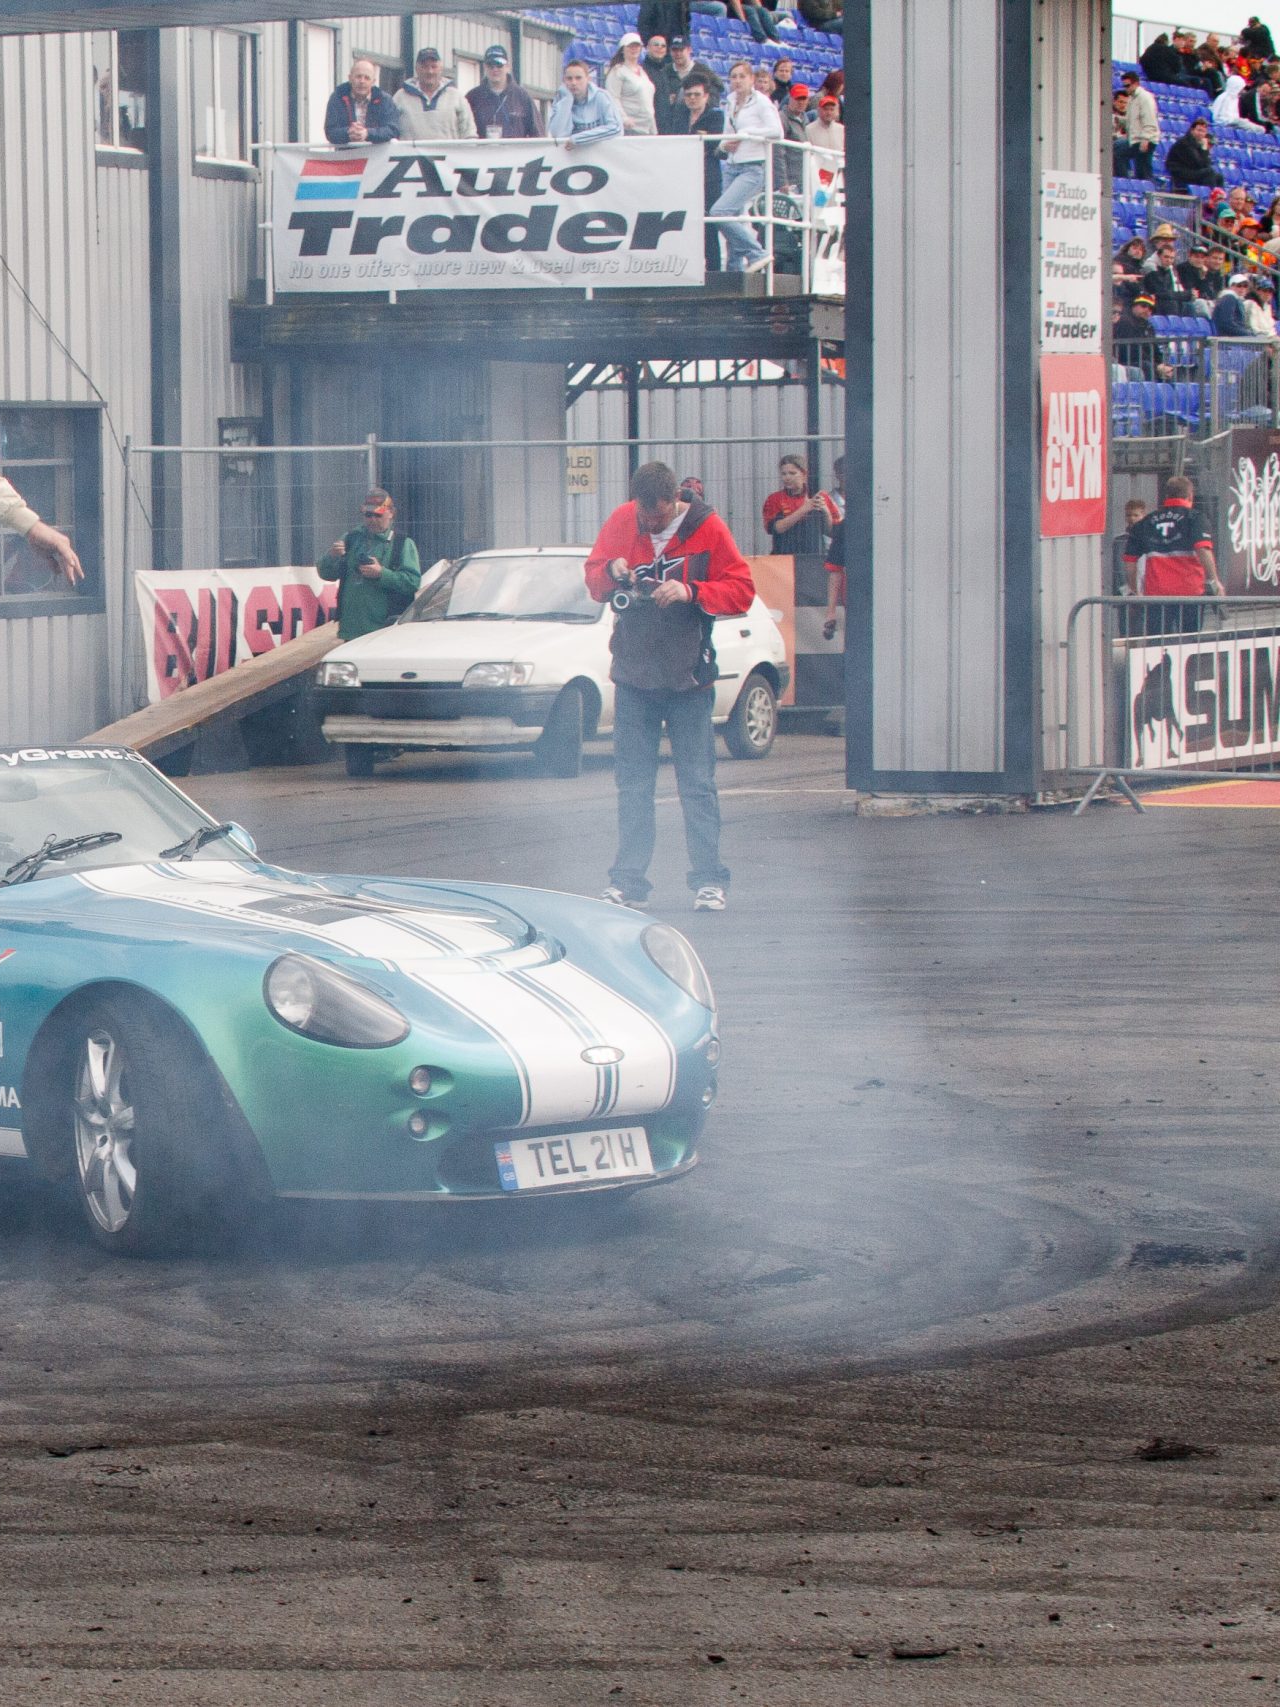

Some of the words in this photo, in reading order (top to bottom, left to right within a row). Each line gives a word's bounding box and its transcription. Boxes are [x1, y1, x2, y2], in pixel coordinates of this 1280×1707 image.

[363, 155, 609, 199] Auto
[1056, 183, 1087, 200] Auto
[1045, 202, 1097, 221] Trader
[288, 205, 687, 257] Trader
[1056, 242, 1087, 259] Auto
[290, 261, 314, 279] No
[320, 263, 351, 278] one
[358, 260, 410, 278] offers
[415, 262, 463, 276] more
[467, 260, 507, 275] new
[511, 258, 526, 274] &
[531, 256, 574, 274] used
[577, 258, 620, 273] cars
[624, 255, 688, 277] locally
[1045, 261, 1097, 280] Trader
[1056, 302, 1087, 318] Auto
[1045, 321, 1097, 339] Trader
[1047, 389, 1102, 446] AUTO
[1046, 445, 1102, 502] GLYM
[527, 1139, 587, 1177] TEL
